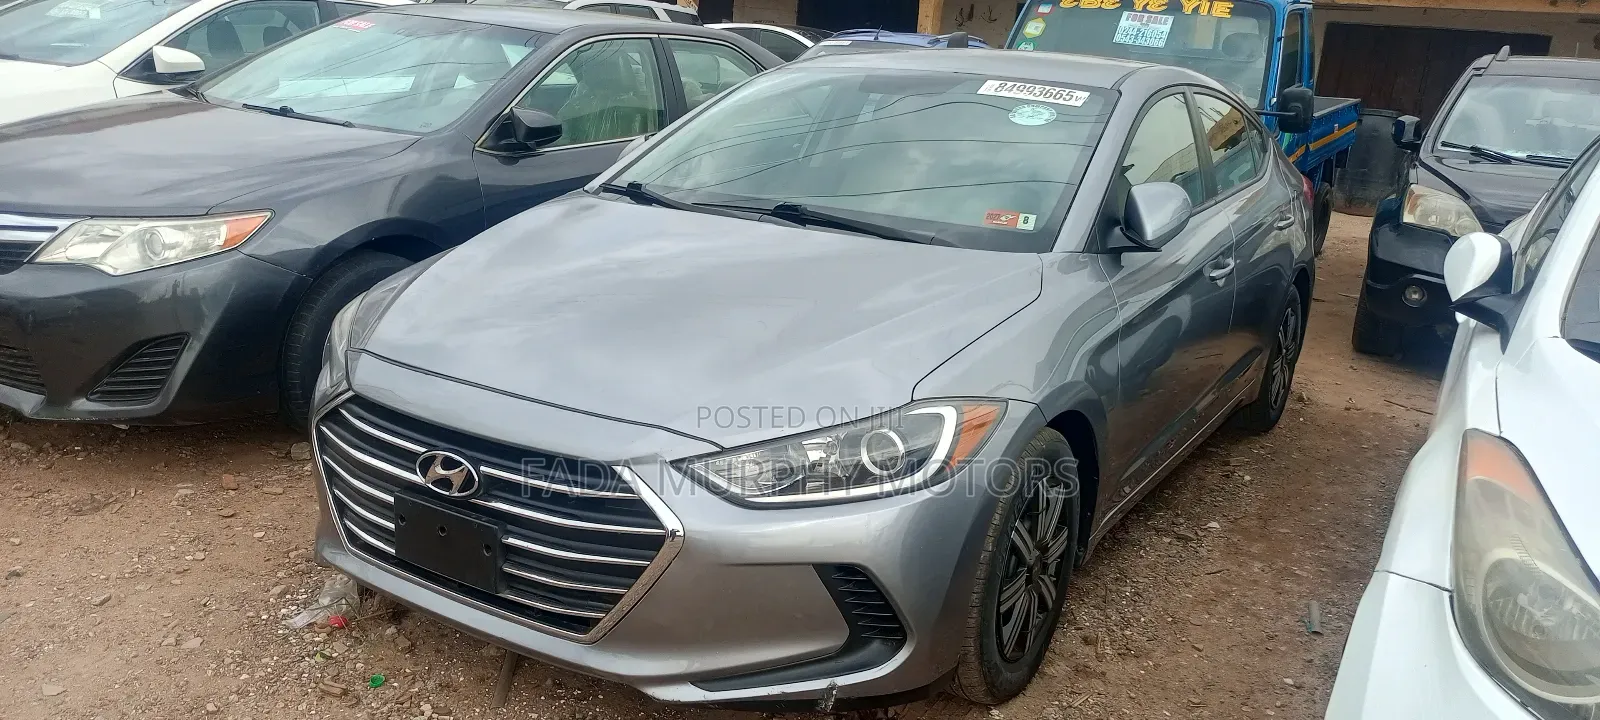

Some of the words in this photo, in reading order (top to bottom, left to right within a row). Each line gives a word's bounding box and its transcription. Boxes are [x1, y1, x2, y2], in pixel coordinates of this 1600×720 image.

[1179, 0, 1234, 18] YIE
[1126, 13, 1145, 23] FOR
[1146, 15, 1170, 25] SALE
[1023, 216, 1029, 224] 8
